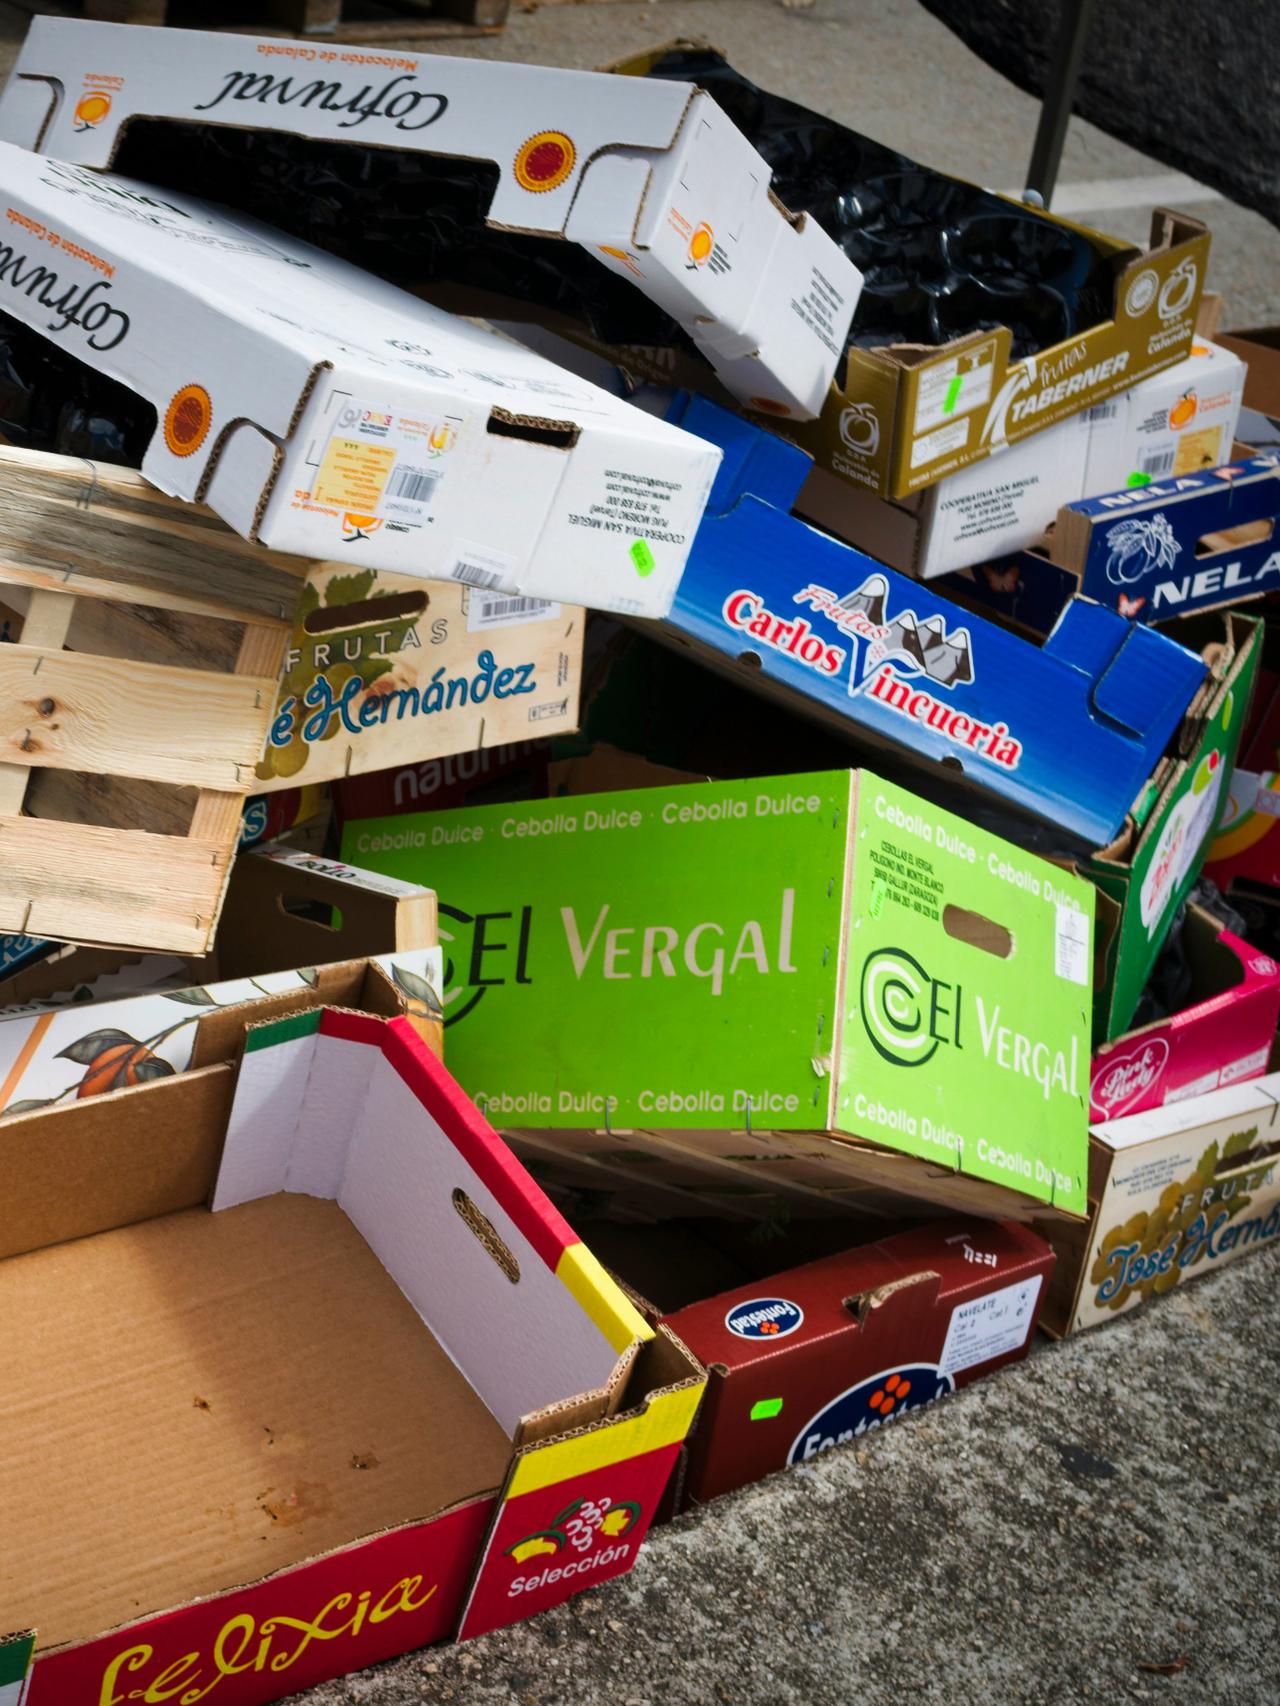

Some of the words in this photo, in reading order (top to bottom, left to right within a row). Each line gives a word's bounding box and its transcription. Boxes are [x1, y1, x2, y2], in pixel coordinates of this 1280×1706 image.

[256, 44, 316, 61] Calanda
[319, 50, 337, 62] de
[340, 52, 418, 71] Melocotón
[194, 70, 450, 131] Cofruval
[6, 208, 46, 240] Calanda
[48, 232, 60, 246] de
[1011, 352, 1129, 423] TABERNER
[1099, 478, 1204, 508] NELA
[568, 514, 602, 529] MIGUEL
[623, 525, 685, 545] COOPERATIVA
[1152, 551, 1280, 609] NELA
[794, 585, 889, 640] Frutas
[285, 618, 449, 674] FRUTAS
[303, 650, 537, 742] Hernández
[726, 592, 847, 673] Carlos
[839, 622, 1022, 768] Vincueria
[358, 829, 426, 854] Cebolla
[431, 823, 484, 847] Dulce
[501, 815, 578, 839] Cebolla
[583, 808, 642, 832] Dulce
[662, 798, 748, 825] Cebolla
[755, 793, 821, 817] Dulce
[874, 795, 933, 842] Cebolla
[936, 826, 977, 864] Dulce
[987, 853, 1041, 898] Cebolla
[468, 905, 532, 986] El
[929, 977, 963, 1050] El
[472, 1091, 552, 1115] Cebolla
[558, 1091, 619, 1115] Dulce
[638, 1090, 724, 1114] Cebolla
[732, 1089, 800, 1113] Dulce
[854, 1093, 917, 1137] Cebolla
[921, 1118, 964, 1151] Dulce
[976, 1138, 1033, 1179] Cebolla
[1035, 1158, 1072, 1193] Dulce
[1098, 1230, 1184, 1303] José
[730, 1301, 797, 1334] Fontestad
[507, 1543, 630, 1599] Selección
